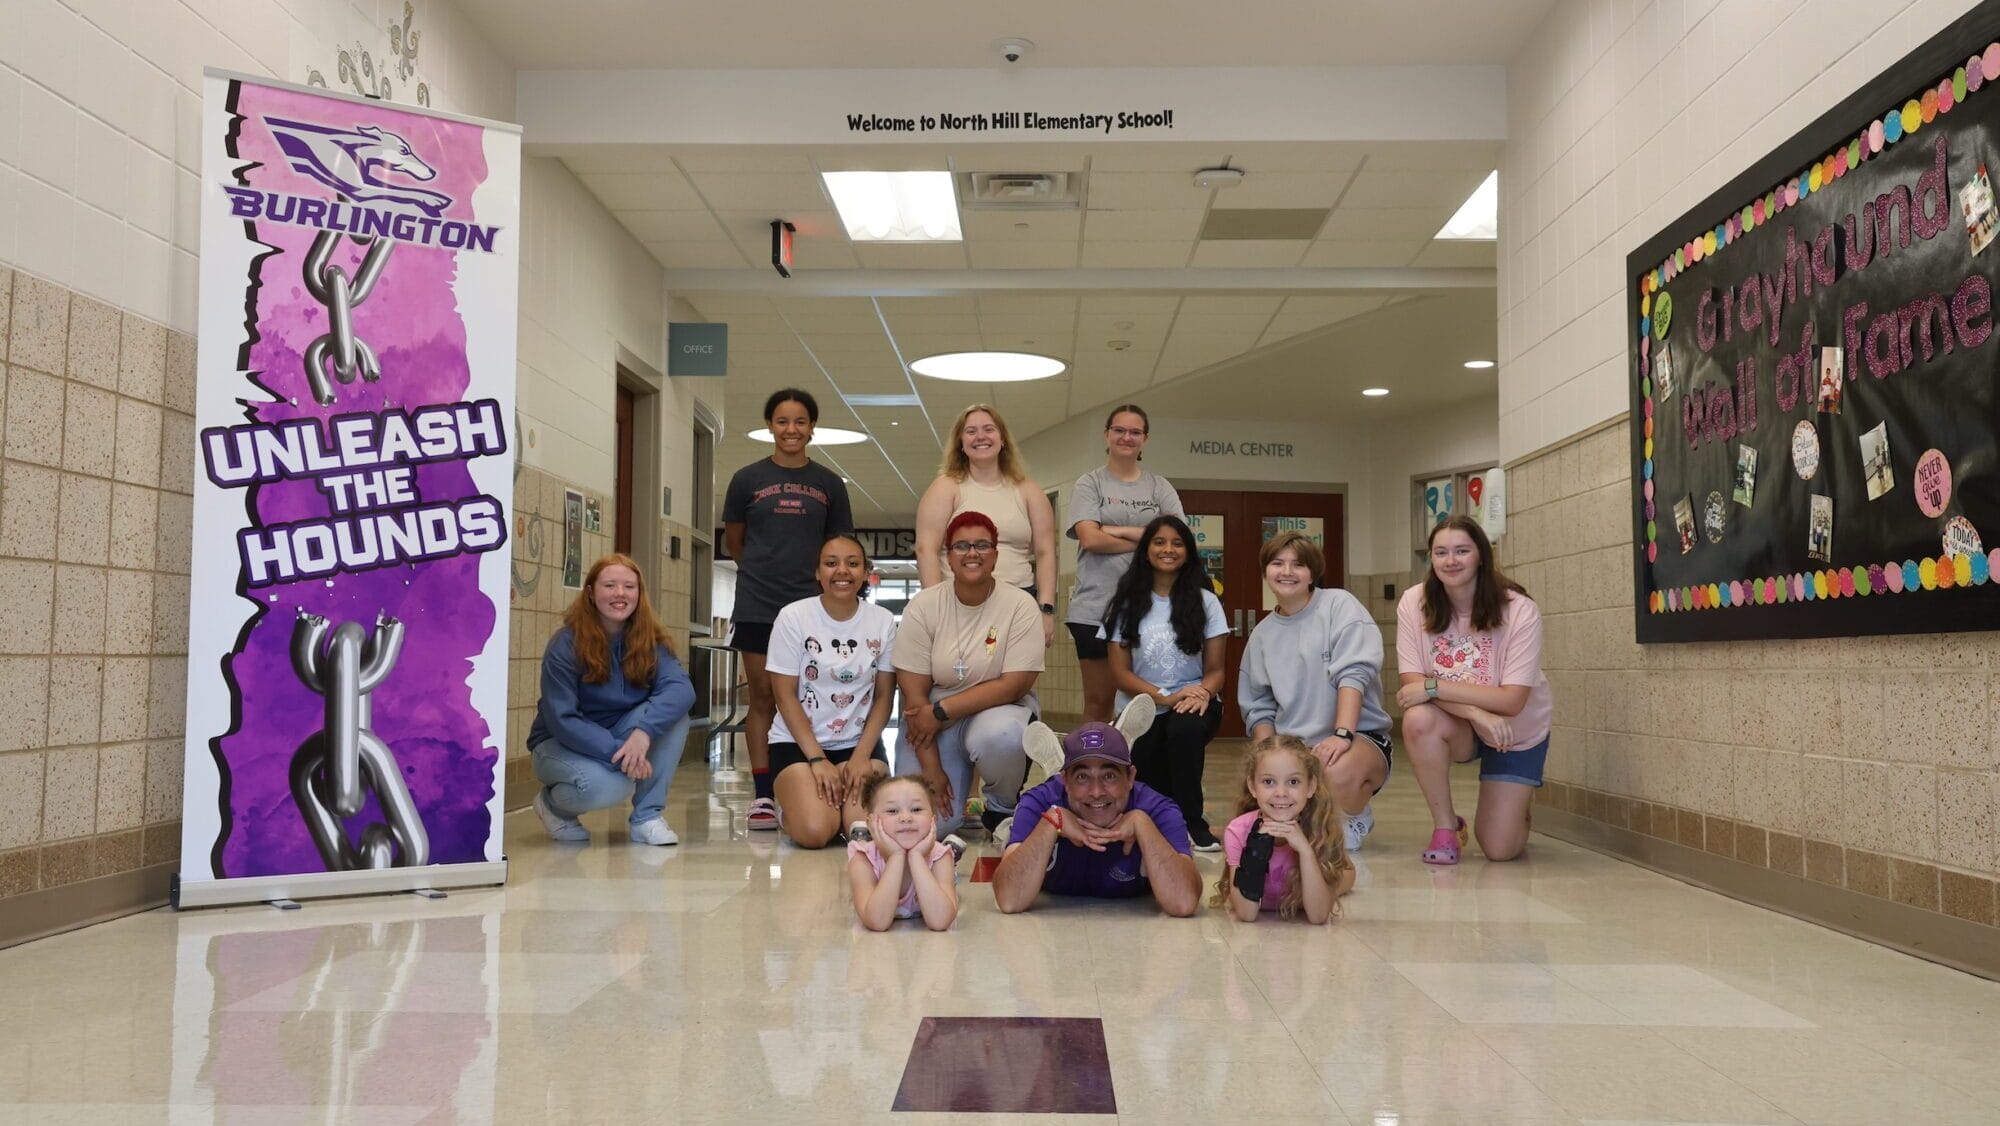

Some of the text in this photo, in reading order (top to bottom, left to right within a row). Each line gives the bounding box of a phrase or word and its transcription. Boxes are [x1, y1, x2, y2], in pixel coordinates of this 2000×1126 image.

[847, 109, 1173, 134] Welcome to North Hill Elementary School!
[223, 186, 500, 252] BURLINGTON
[1697, 135, 1949, 352] Grayhound
[683, 344, 713, 354] OFFICE
[1776, 320, 1814, 412] of
[1844, 274, 1992, 382] Fame
[207, 404, 501, 482] UNLEASH
[1190, 440, 1294, 457] MEDIA CENTER
[1918, 456, 1943, 483] NEVER
[1922, 475, 1941, 500] give
[322, 467, 415, 512] THE
[243, 500, 501, 582] HOUNDS
[1081, 730, 1104, 749] B
